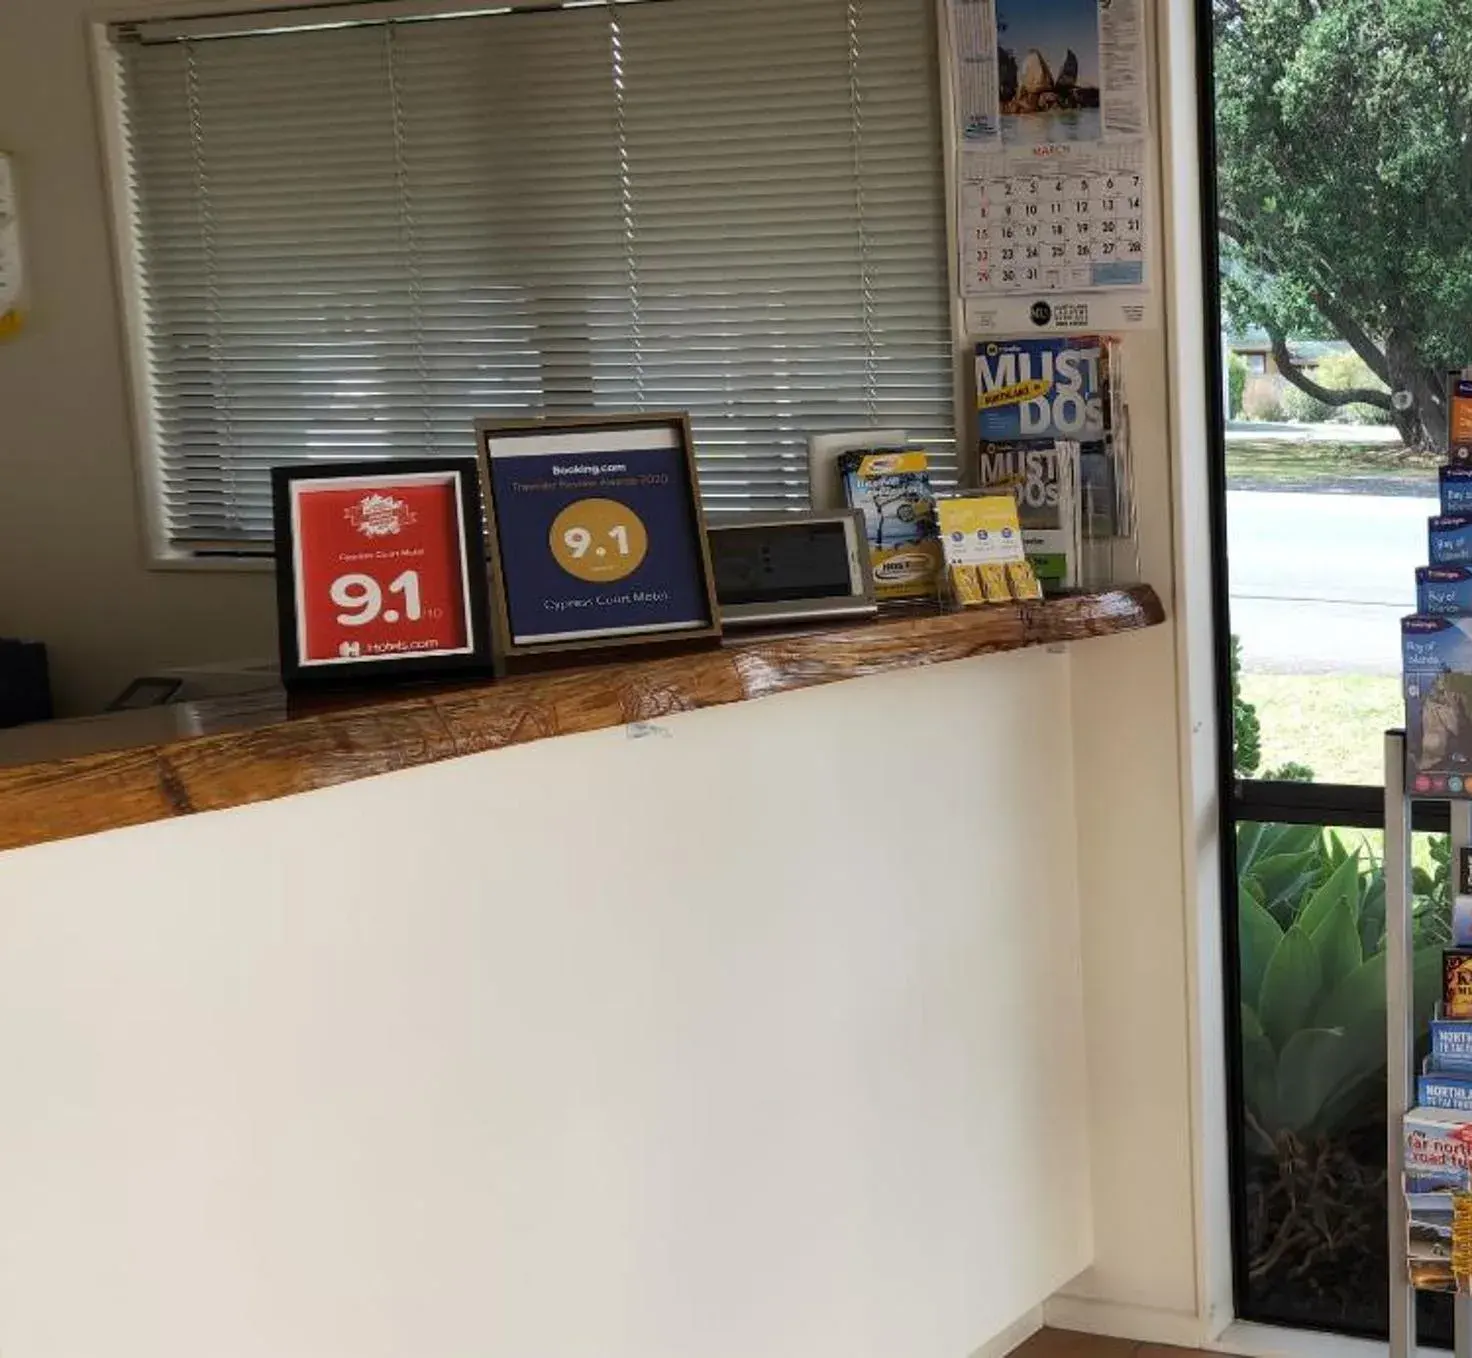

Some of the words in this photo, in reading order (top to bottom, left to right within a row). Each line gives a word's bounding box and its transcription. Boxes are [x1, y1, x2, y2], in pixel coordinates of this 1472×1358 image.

[1051, 203, 1061, 213] 11
[1076, 202, 1088, 212] 12
[1102, 200, 1114, 210] 13
[1128, 198, 1139, 208] 14
[1025, 205, 1037, 215] 10
[1002, 228, 1013, 238] 16
[1077, 223, 1088, 233] 19
[1102, 243, 1115, 254] 27
[1002, 249, 1014, 260] 23
[1002, 271, 1014, 281] 30
[1026, 268, 1037, 279] 31
[975, 349, 1102, 396] MUST
[552, 462, 627, 477] Booking.com
[980, 451, 1058, 487] MUST
[639, 474, 668, 486] 2020
[563, 525, 630, 558] 9.1
[330, 570, 421, 626] 9.1
[543, 598, 592, 613] Cypress
[596, 594, 631, 609] Court
[633, 591, 668, 604] Motel
[367, 638, 439, 652] Hotels.com
[1413, 1151, 1446, 1166] road
